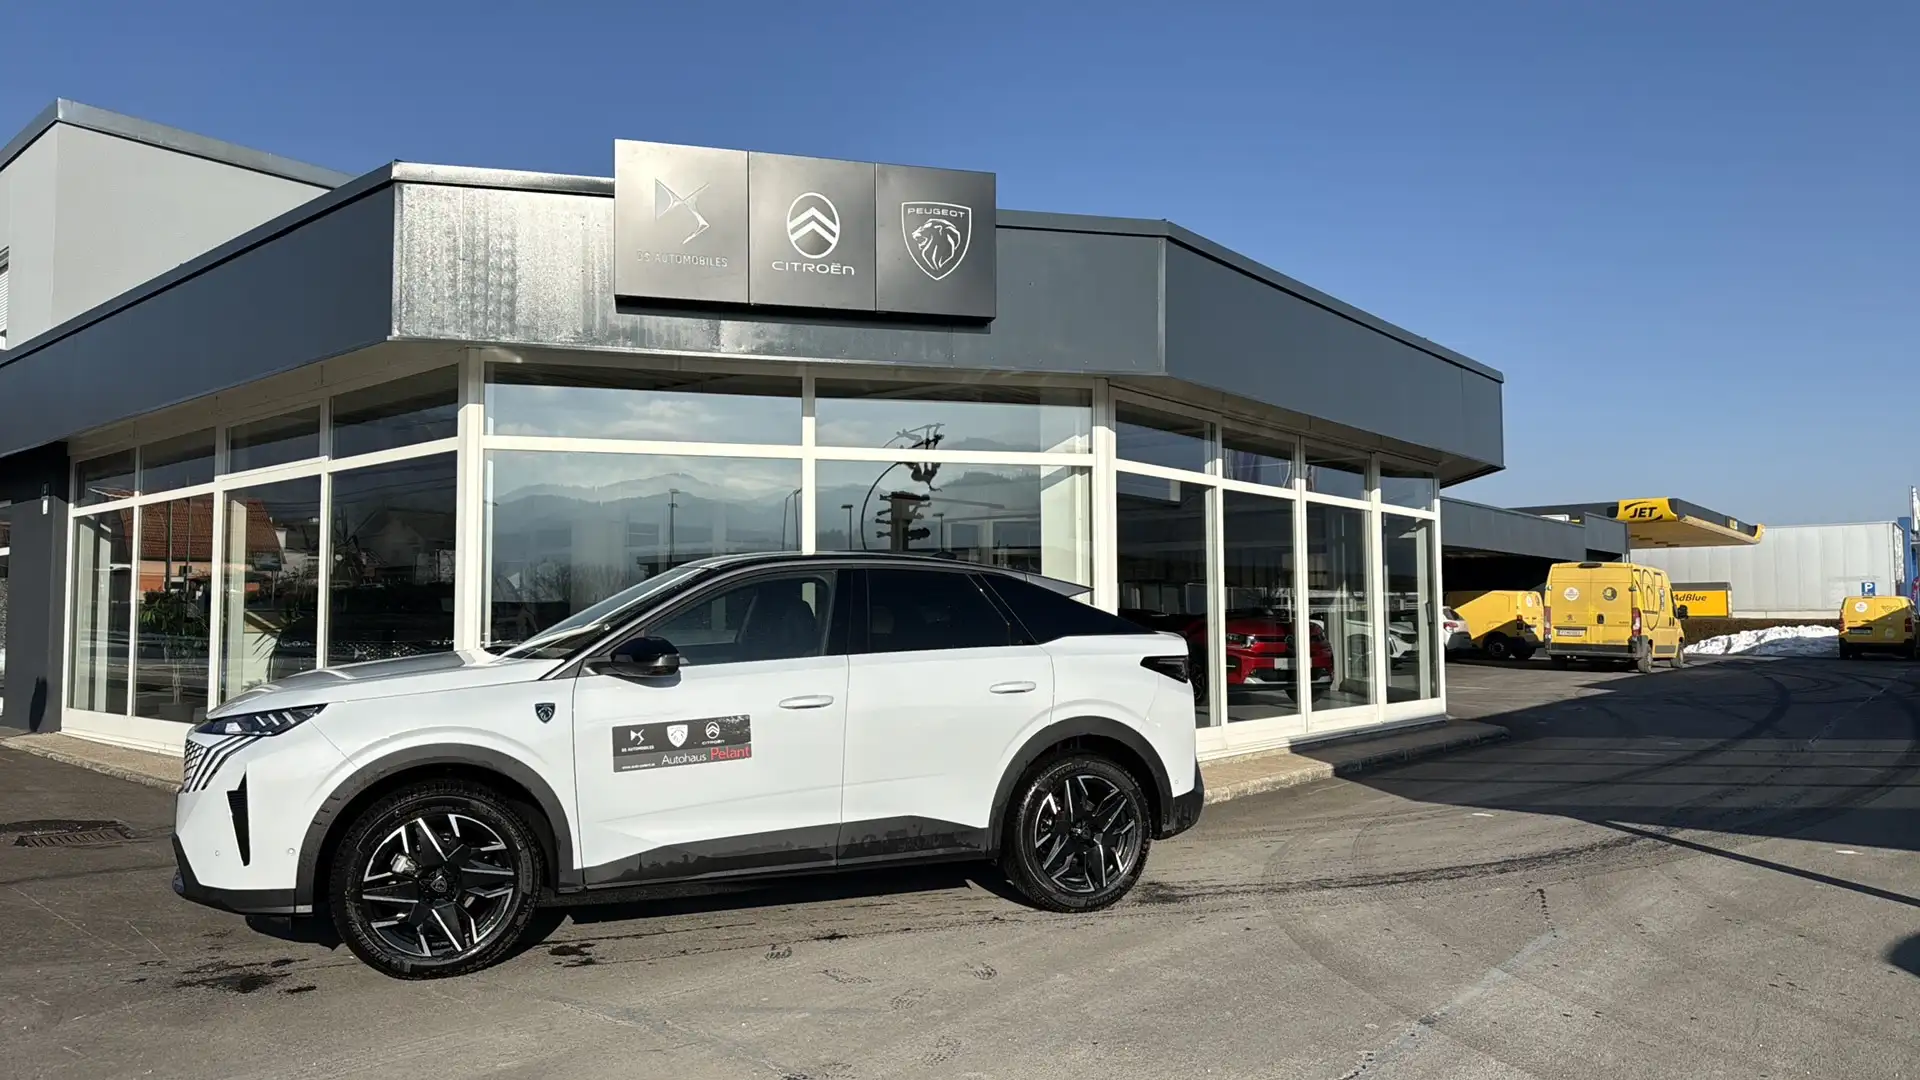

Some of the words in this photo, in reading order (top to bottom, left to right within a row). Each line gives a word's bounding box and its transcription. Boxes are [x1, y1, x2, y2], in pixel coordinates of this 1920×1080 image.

[907, 207, 966, 218] PEUGEOT
[654, 253, 729, 268] AUTOMOBILES
[771, 261, 855, 276] CITROËN
[1629, 507, 1658, 518] JET
[1865, 582, 1874, 592] P
[1673, 593, 1707, 602] AdBlue
[661, 753, 707, 765] Autohaus
[710, 745, 750, 760] Pelant
